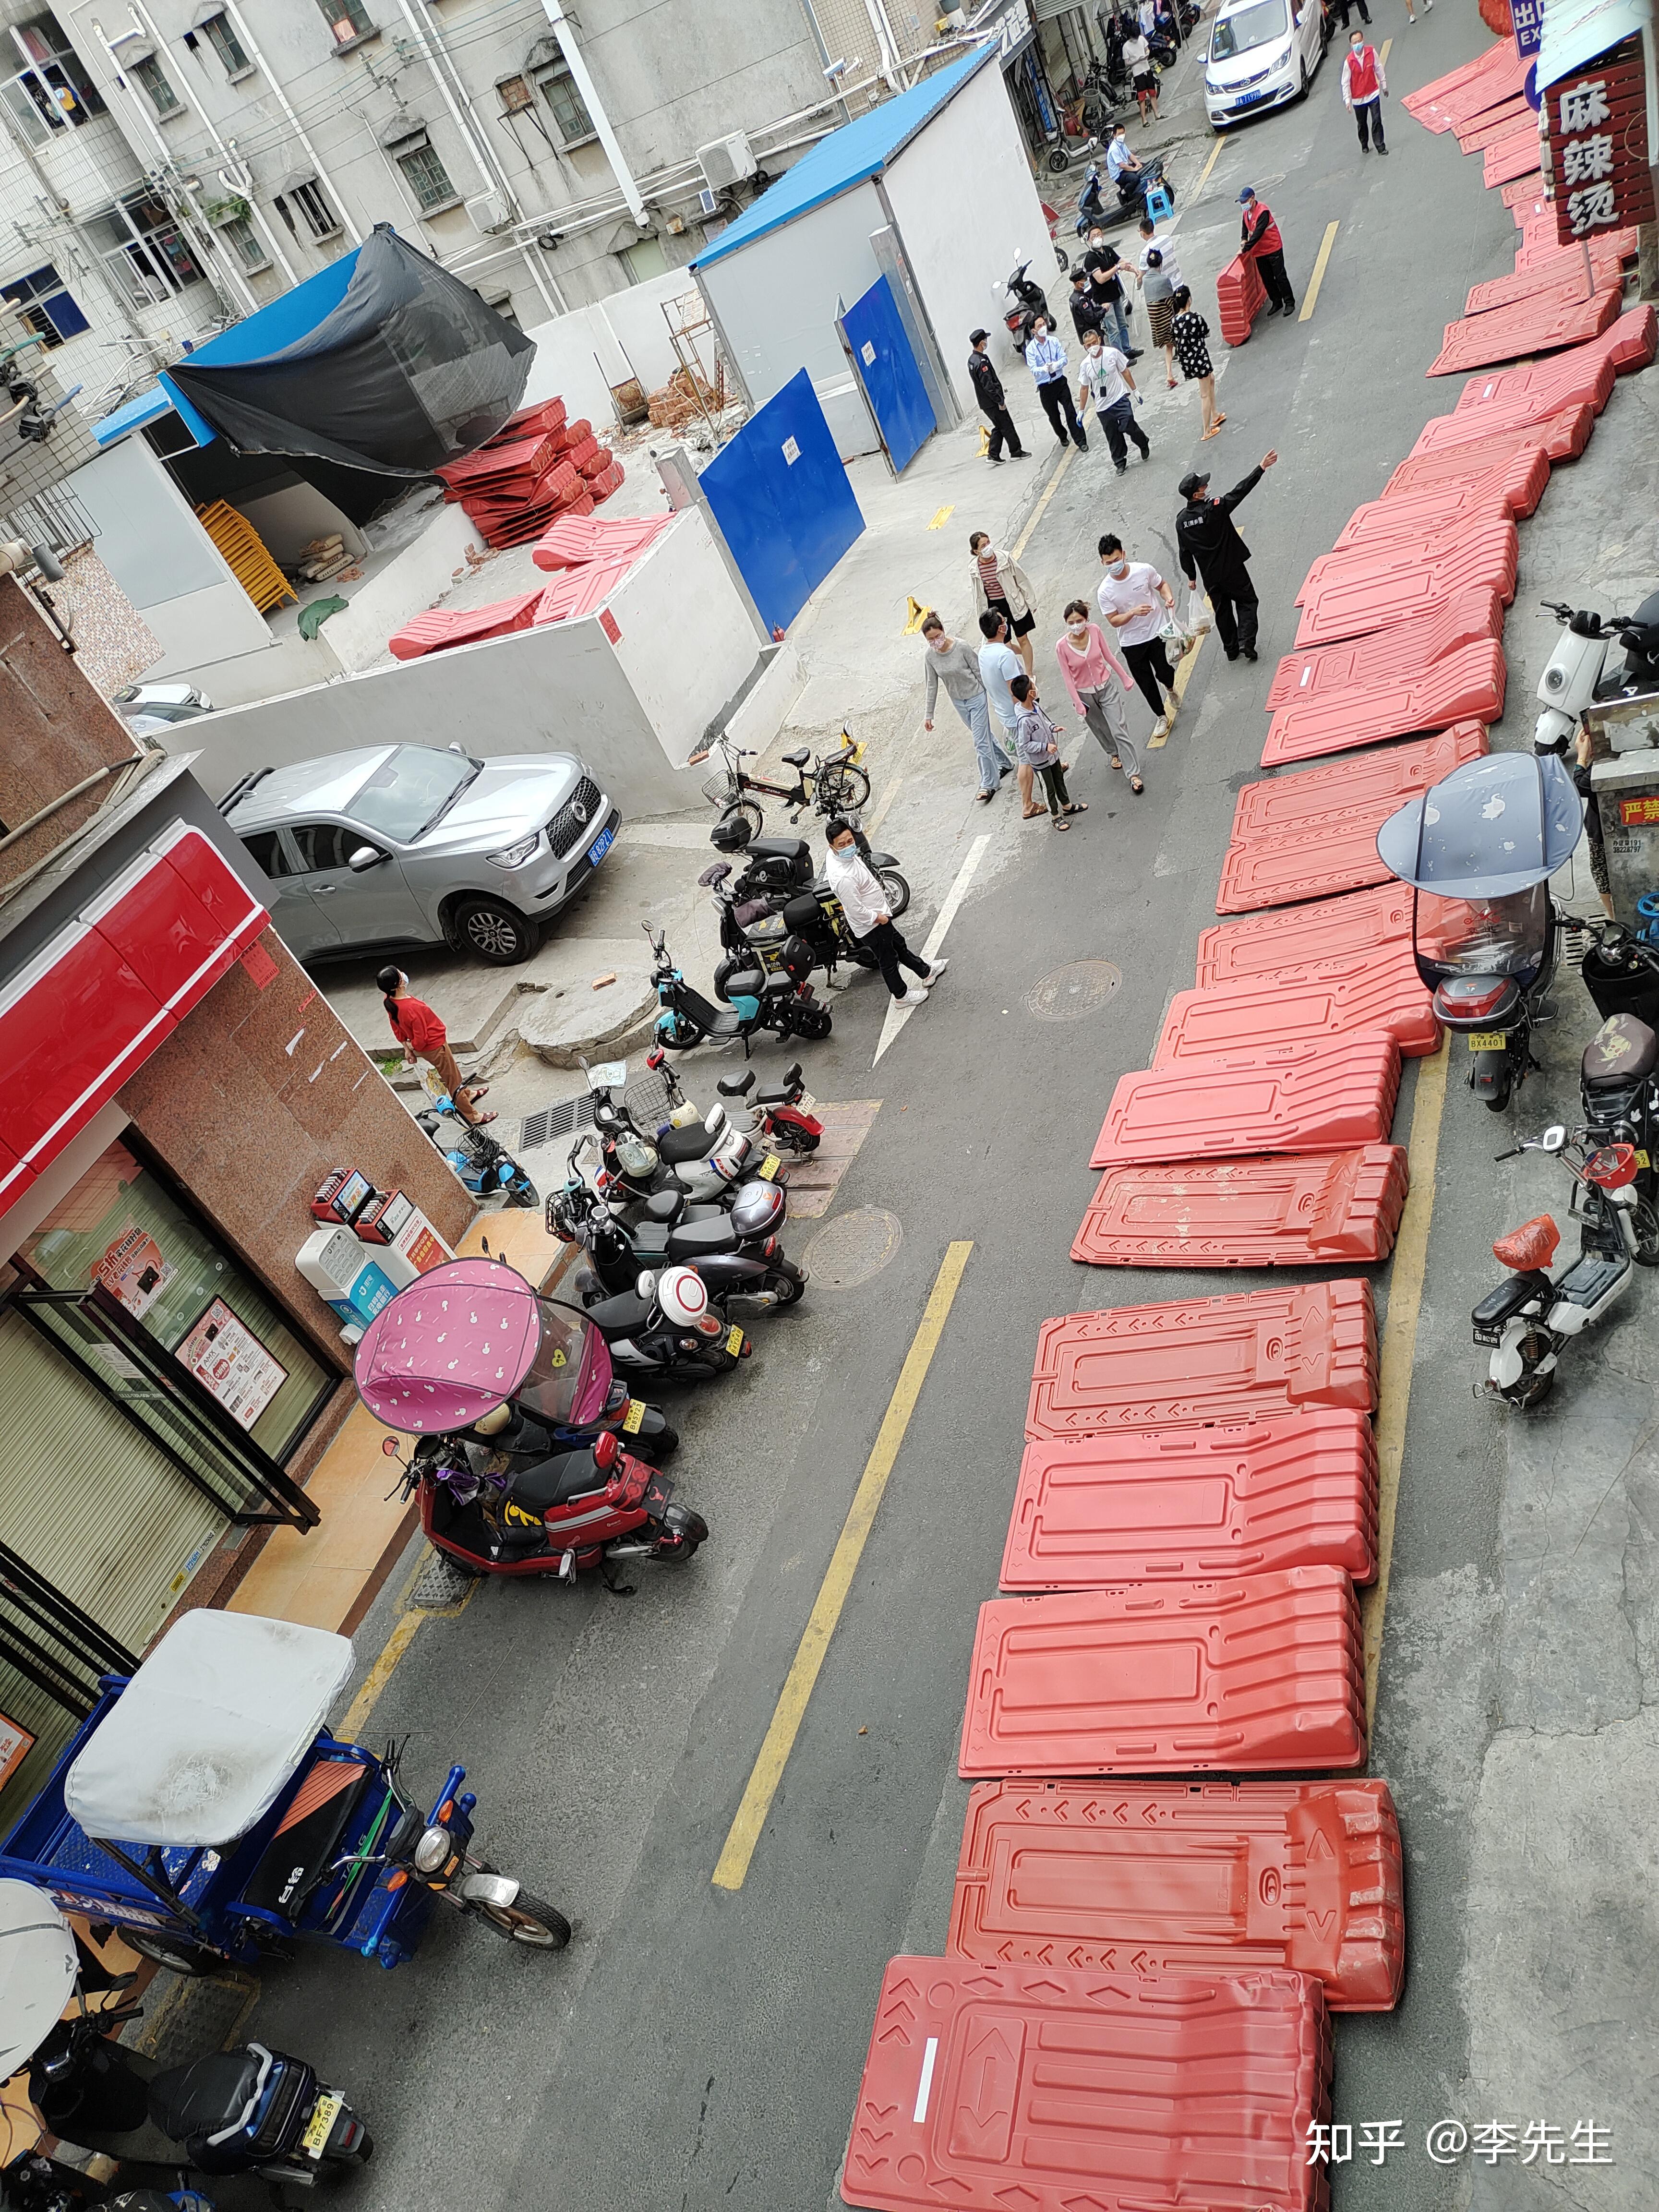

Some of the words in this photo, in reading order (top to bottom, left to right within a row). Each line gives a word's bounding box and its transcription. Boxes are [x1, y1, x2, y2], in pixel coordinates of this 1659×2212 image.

[1521, 25, 1541, 46] EX
[1560, 80, 1619, 235] 麻辣烫
[1623, 799, 1659, 822] 严禁
[1471, 1039, 1503, 1047] BX4401
[801, 1096, 813, 1114] B17721
[731, 1329, 741, 1353] B4Y549
[201, 1348, 216, 1366] AMX
[629, 1403, 642, 1430] B85723
[339, 1832, 368, 1882] TALG
[312, 2103, 334, 2146] BF7389
